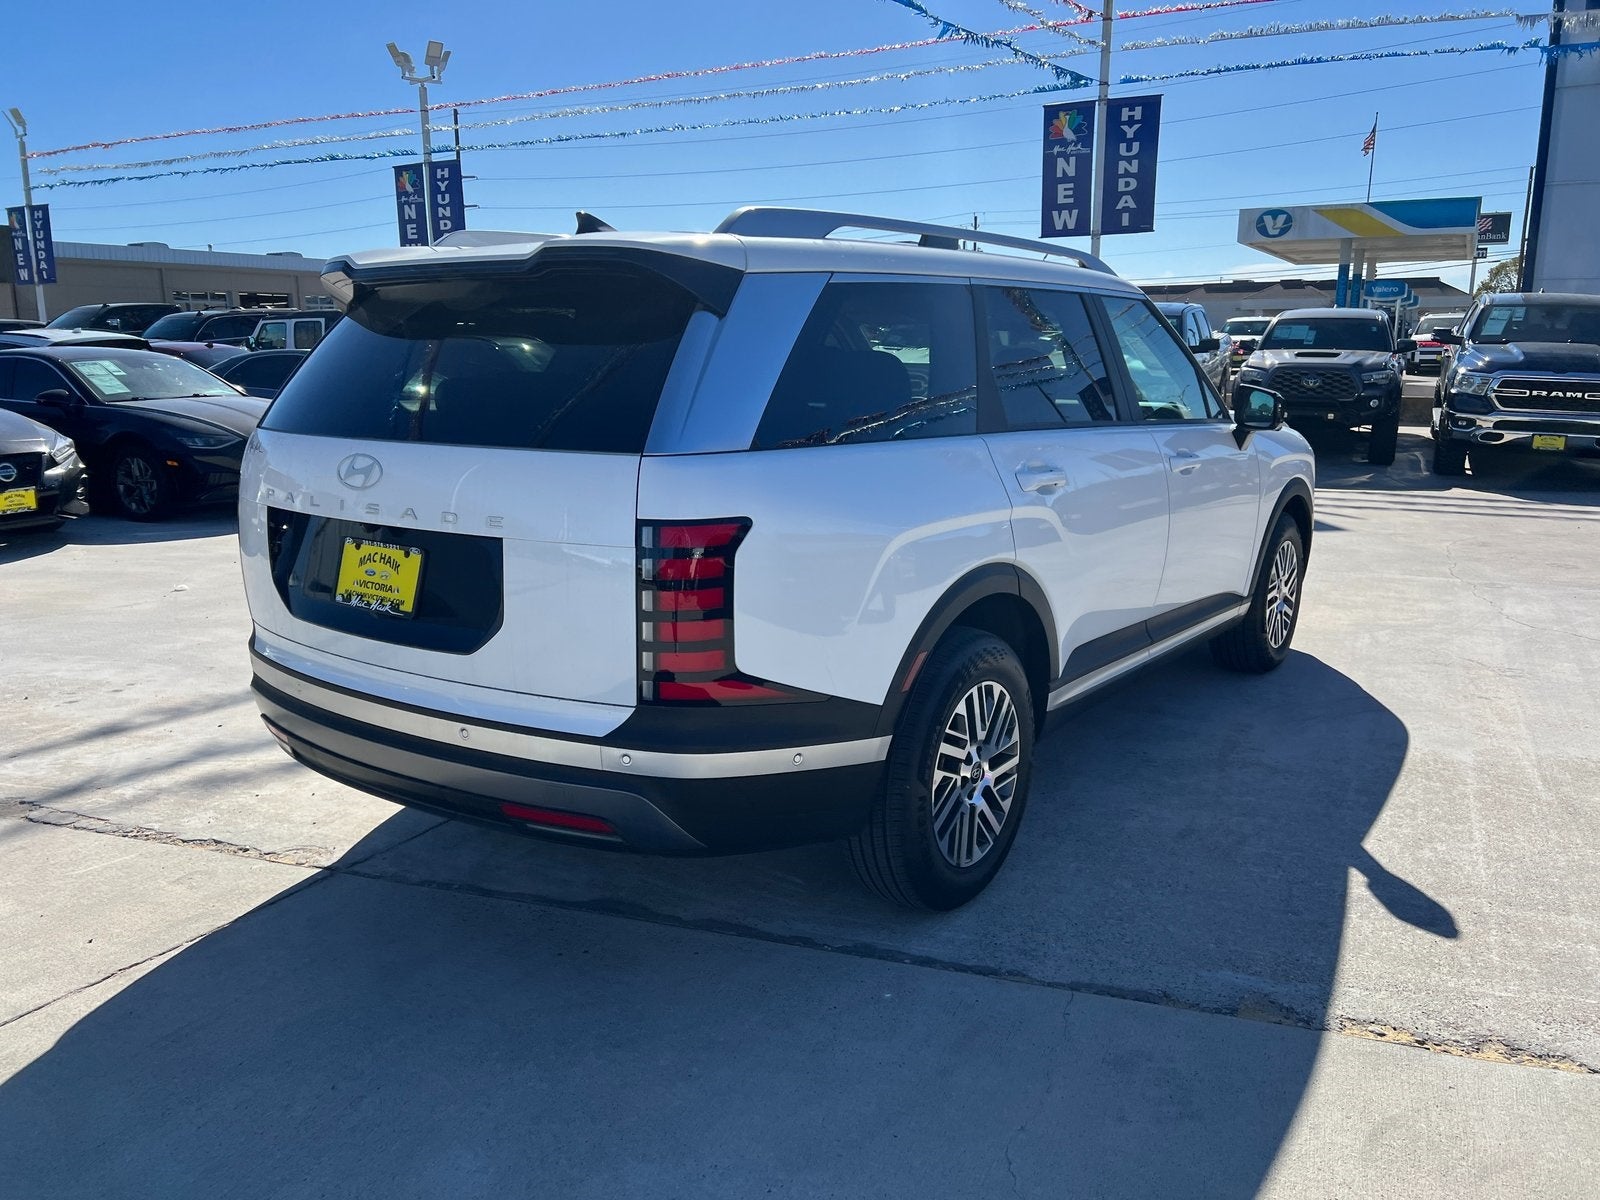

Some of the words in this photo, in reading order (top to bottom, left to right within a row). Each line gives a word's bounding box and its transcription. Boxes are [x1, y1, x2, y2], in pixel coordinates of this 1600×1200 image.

[1115, 106, 1143, 227] HYUNDAI
[436, 168, 452, 237] HYUND
[1051, 156, 1079, 231] NEW
[34, 210, 48, 279] HYUNDAI
[403, 204, 422, 246] NE
[14, 238, 29, 281] NEW
[1531, 390, 1583, 398] RAM
[266, 488, 505, 529] PALISADE
[358, 552, 379, 568] MAC
[379, 552, 401, 575] HAIK
[349, 595, 370, 609] Mac
[359, 579, 394, 594] VICTORIA
